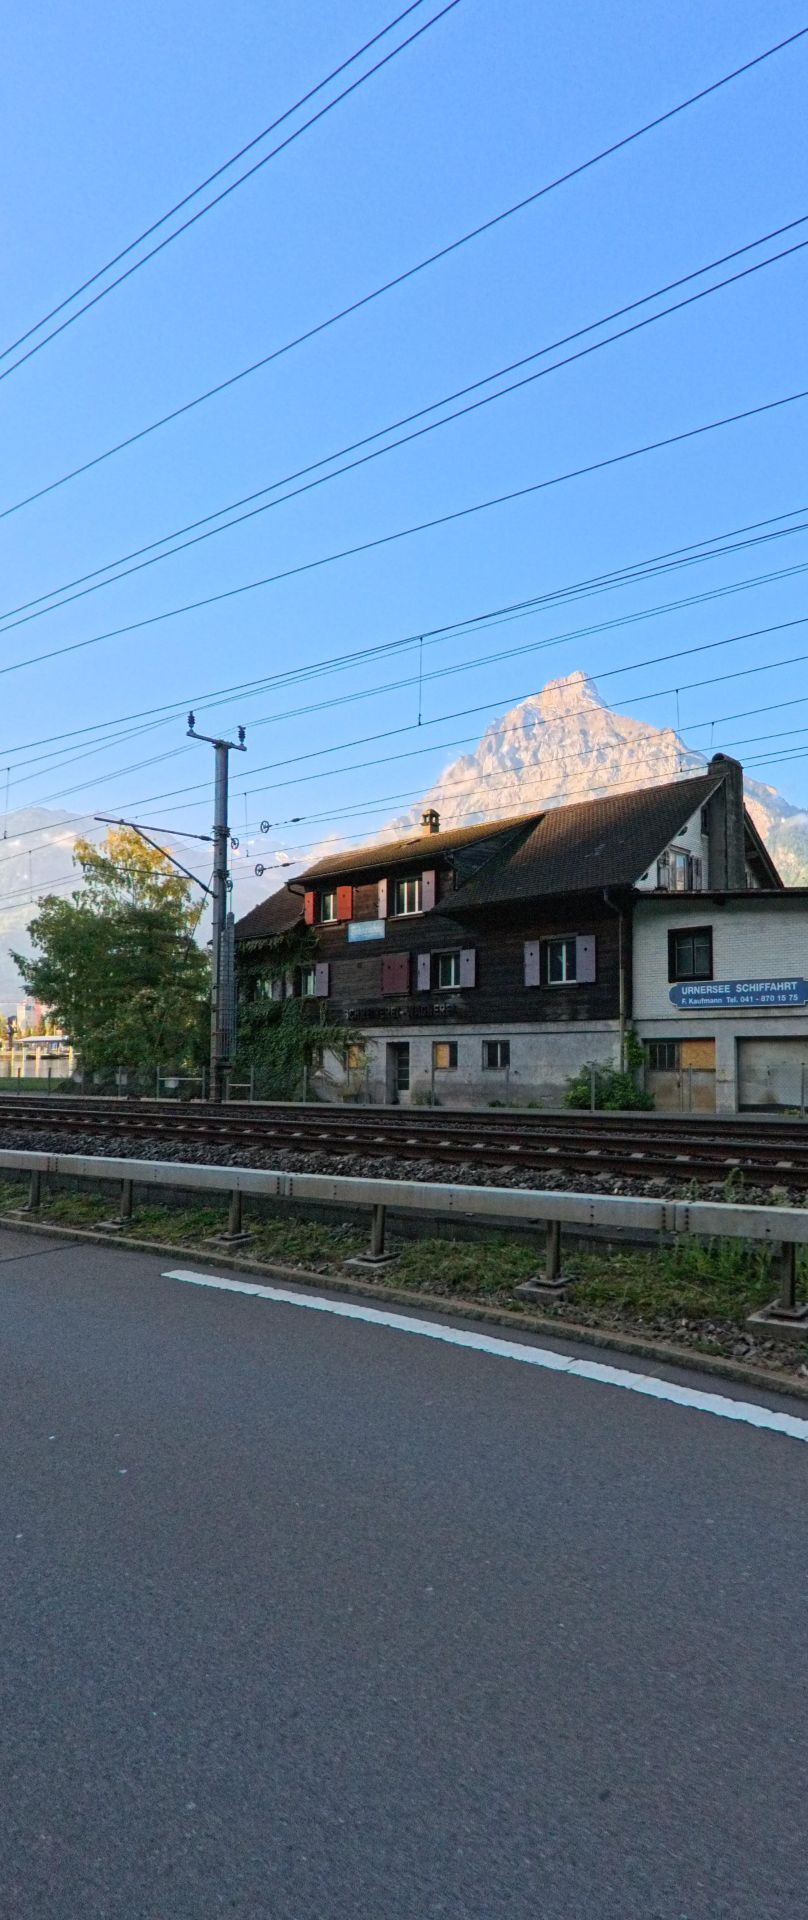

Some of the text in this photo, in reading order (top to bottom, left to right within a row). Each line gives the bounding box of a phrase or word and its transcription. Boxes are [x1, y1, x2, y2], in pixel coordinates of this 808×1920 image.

[681, 981, 798, 995] URNERSEE SCHIFFAHRT
[688, 997, 723, 1005] Kaufmann
[740, 995, 754, 1003] 041
[760, 994, 775, 1002] 870
[777, 994, 787, 1002] 15
[788, 993, 799, 1001] 75
